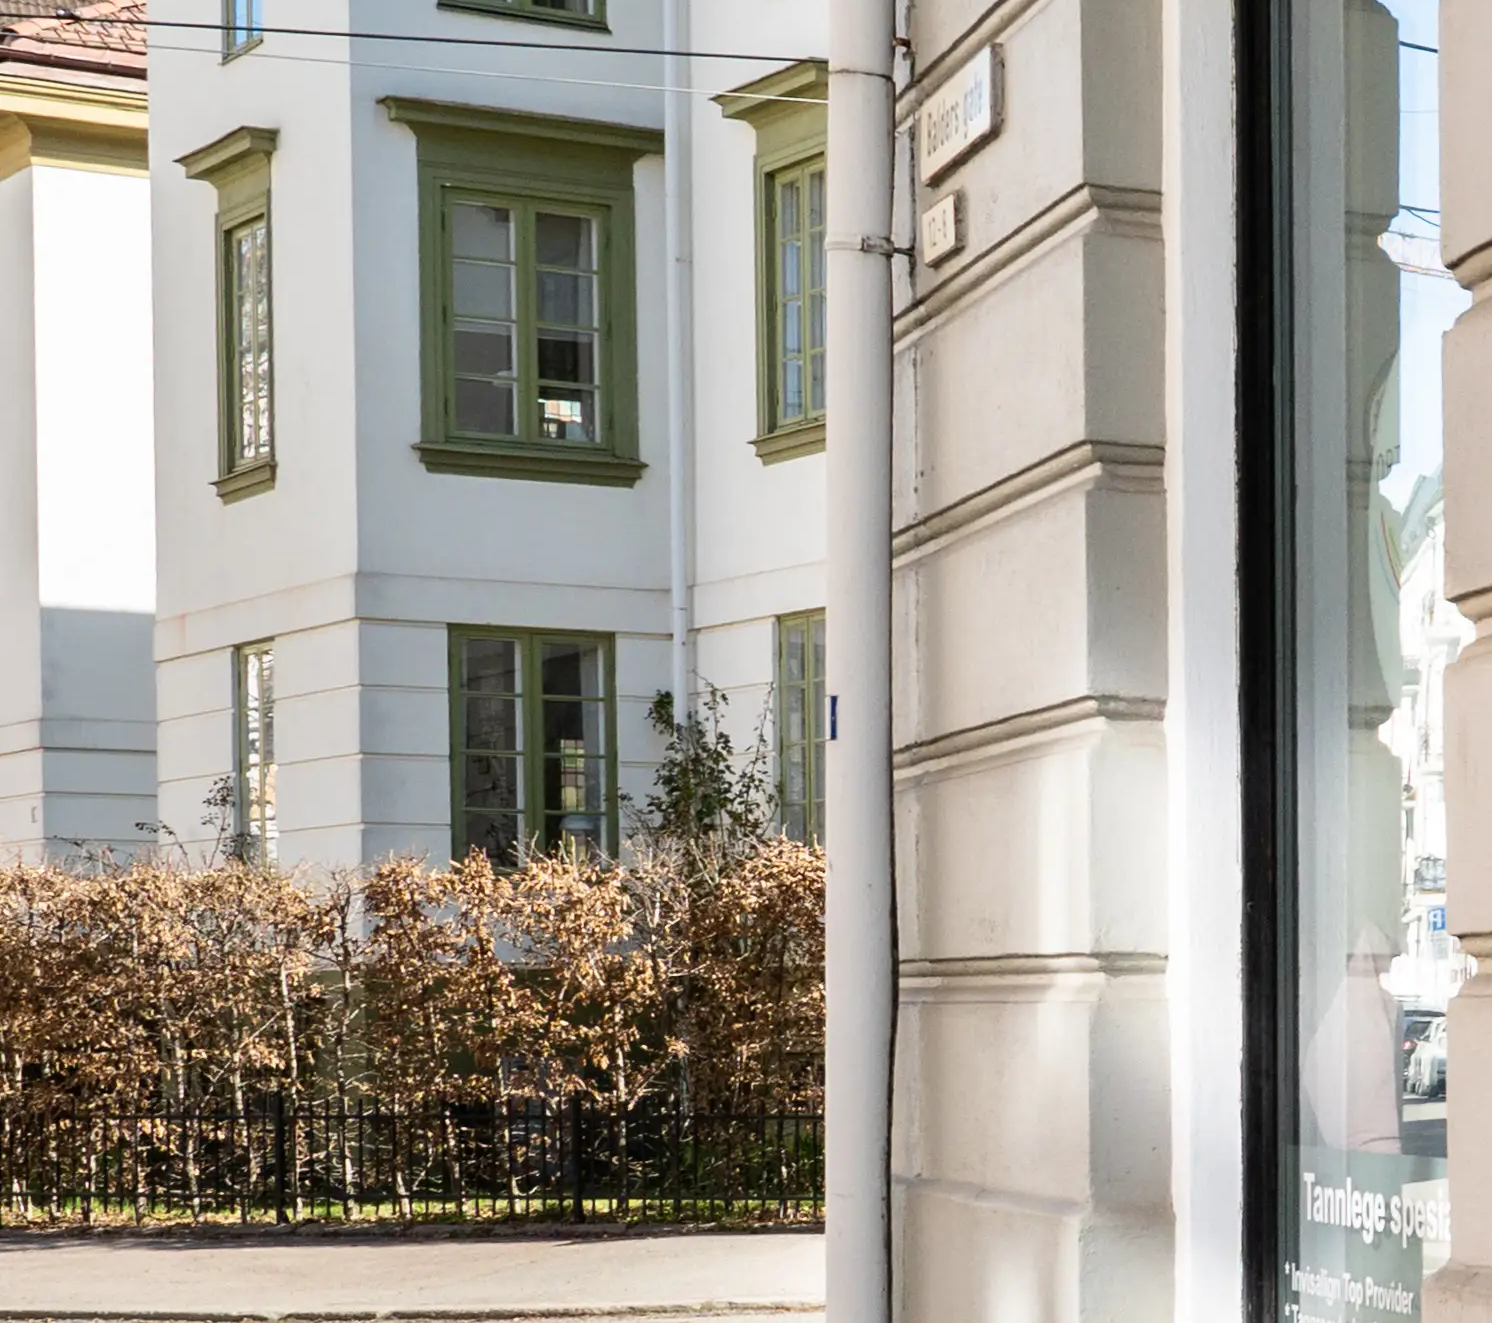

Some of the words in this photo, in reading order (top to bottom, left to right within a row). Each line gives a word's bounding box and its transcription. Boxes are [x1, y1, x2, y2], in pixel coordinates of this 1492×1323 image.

[1303, 1172, 1386, 1245] Tannlege
[1291, 1262, 1341, 1307] Invisalign
[1342, 1272, 1364, 1313] Top
[1365, 1276, 1415, 1315] Provider
